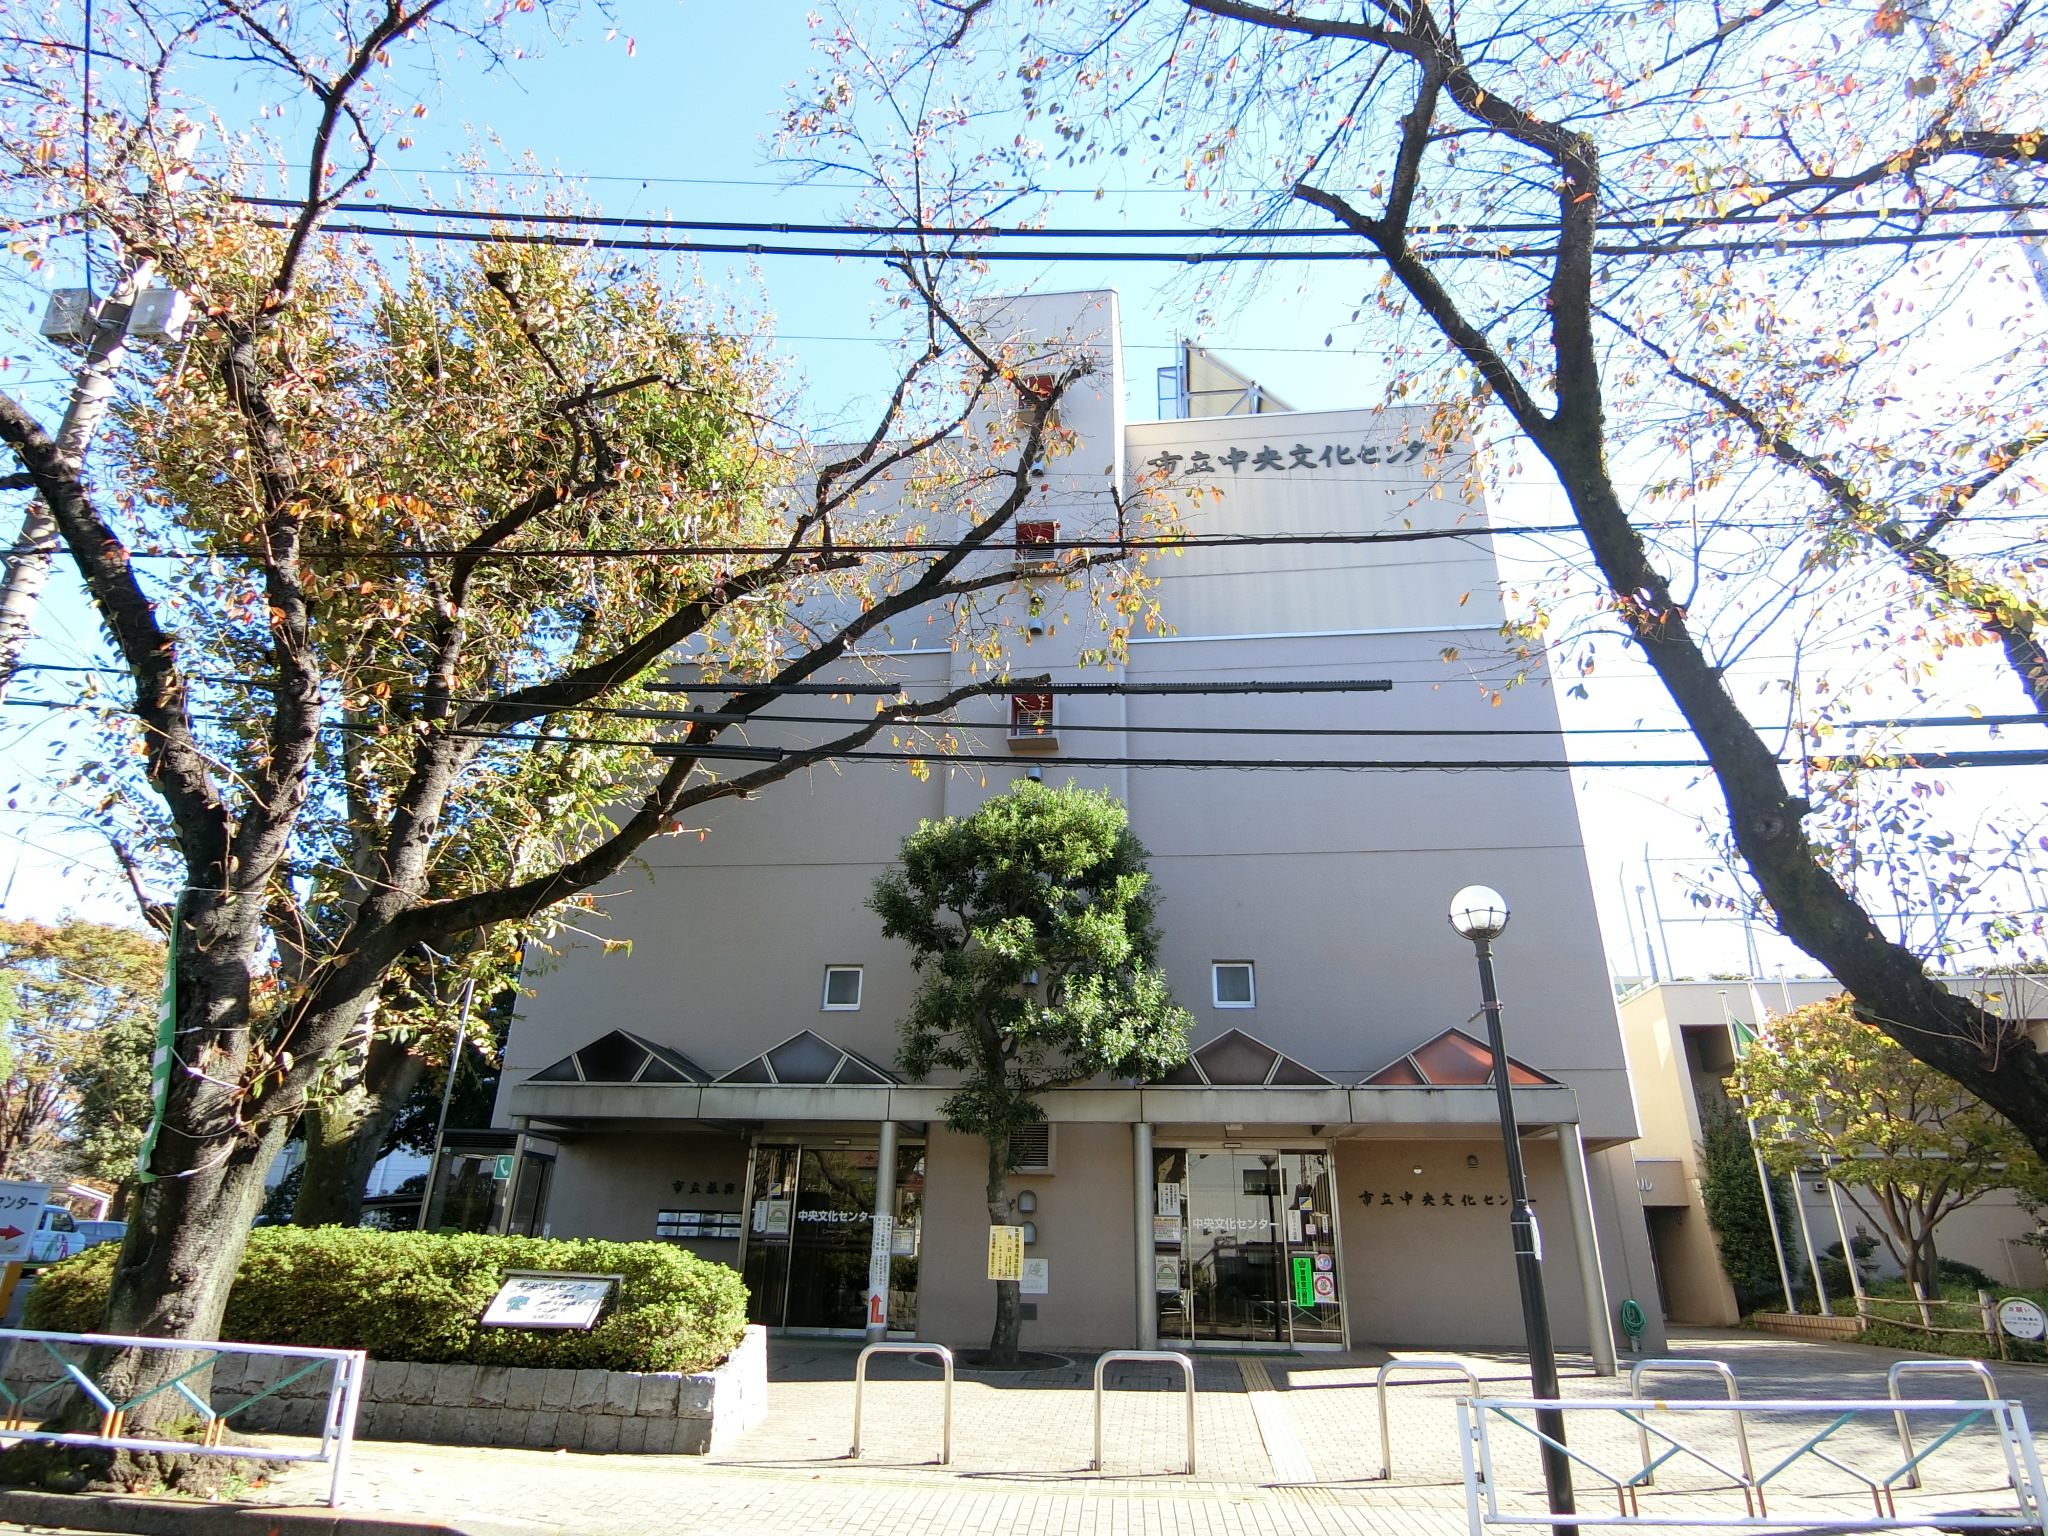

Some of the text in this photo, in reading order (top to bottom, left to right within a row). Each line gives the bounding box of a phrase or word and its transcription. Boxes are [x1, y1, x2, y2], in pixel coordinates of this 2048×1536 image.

[1147, 439, 1453, 475] 市立中央文化センター
[1358, 1190, 1537, 1207] 市立中央文化センー
[798, 1209, 874, 1222] 中央文化センター
[1192, 1217, 1280, 1230] 中央文化センター
